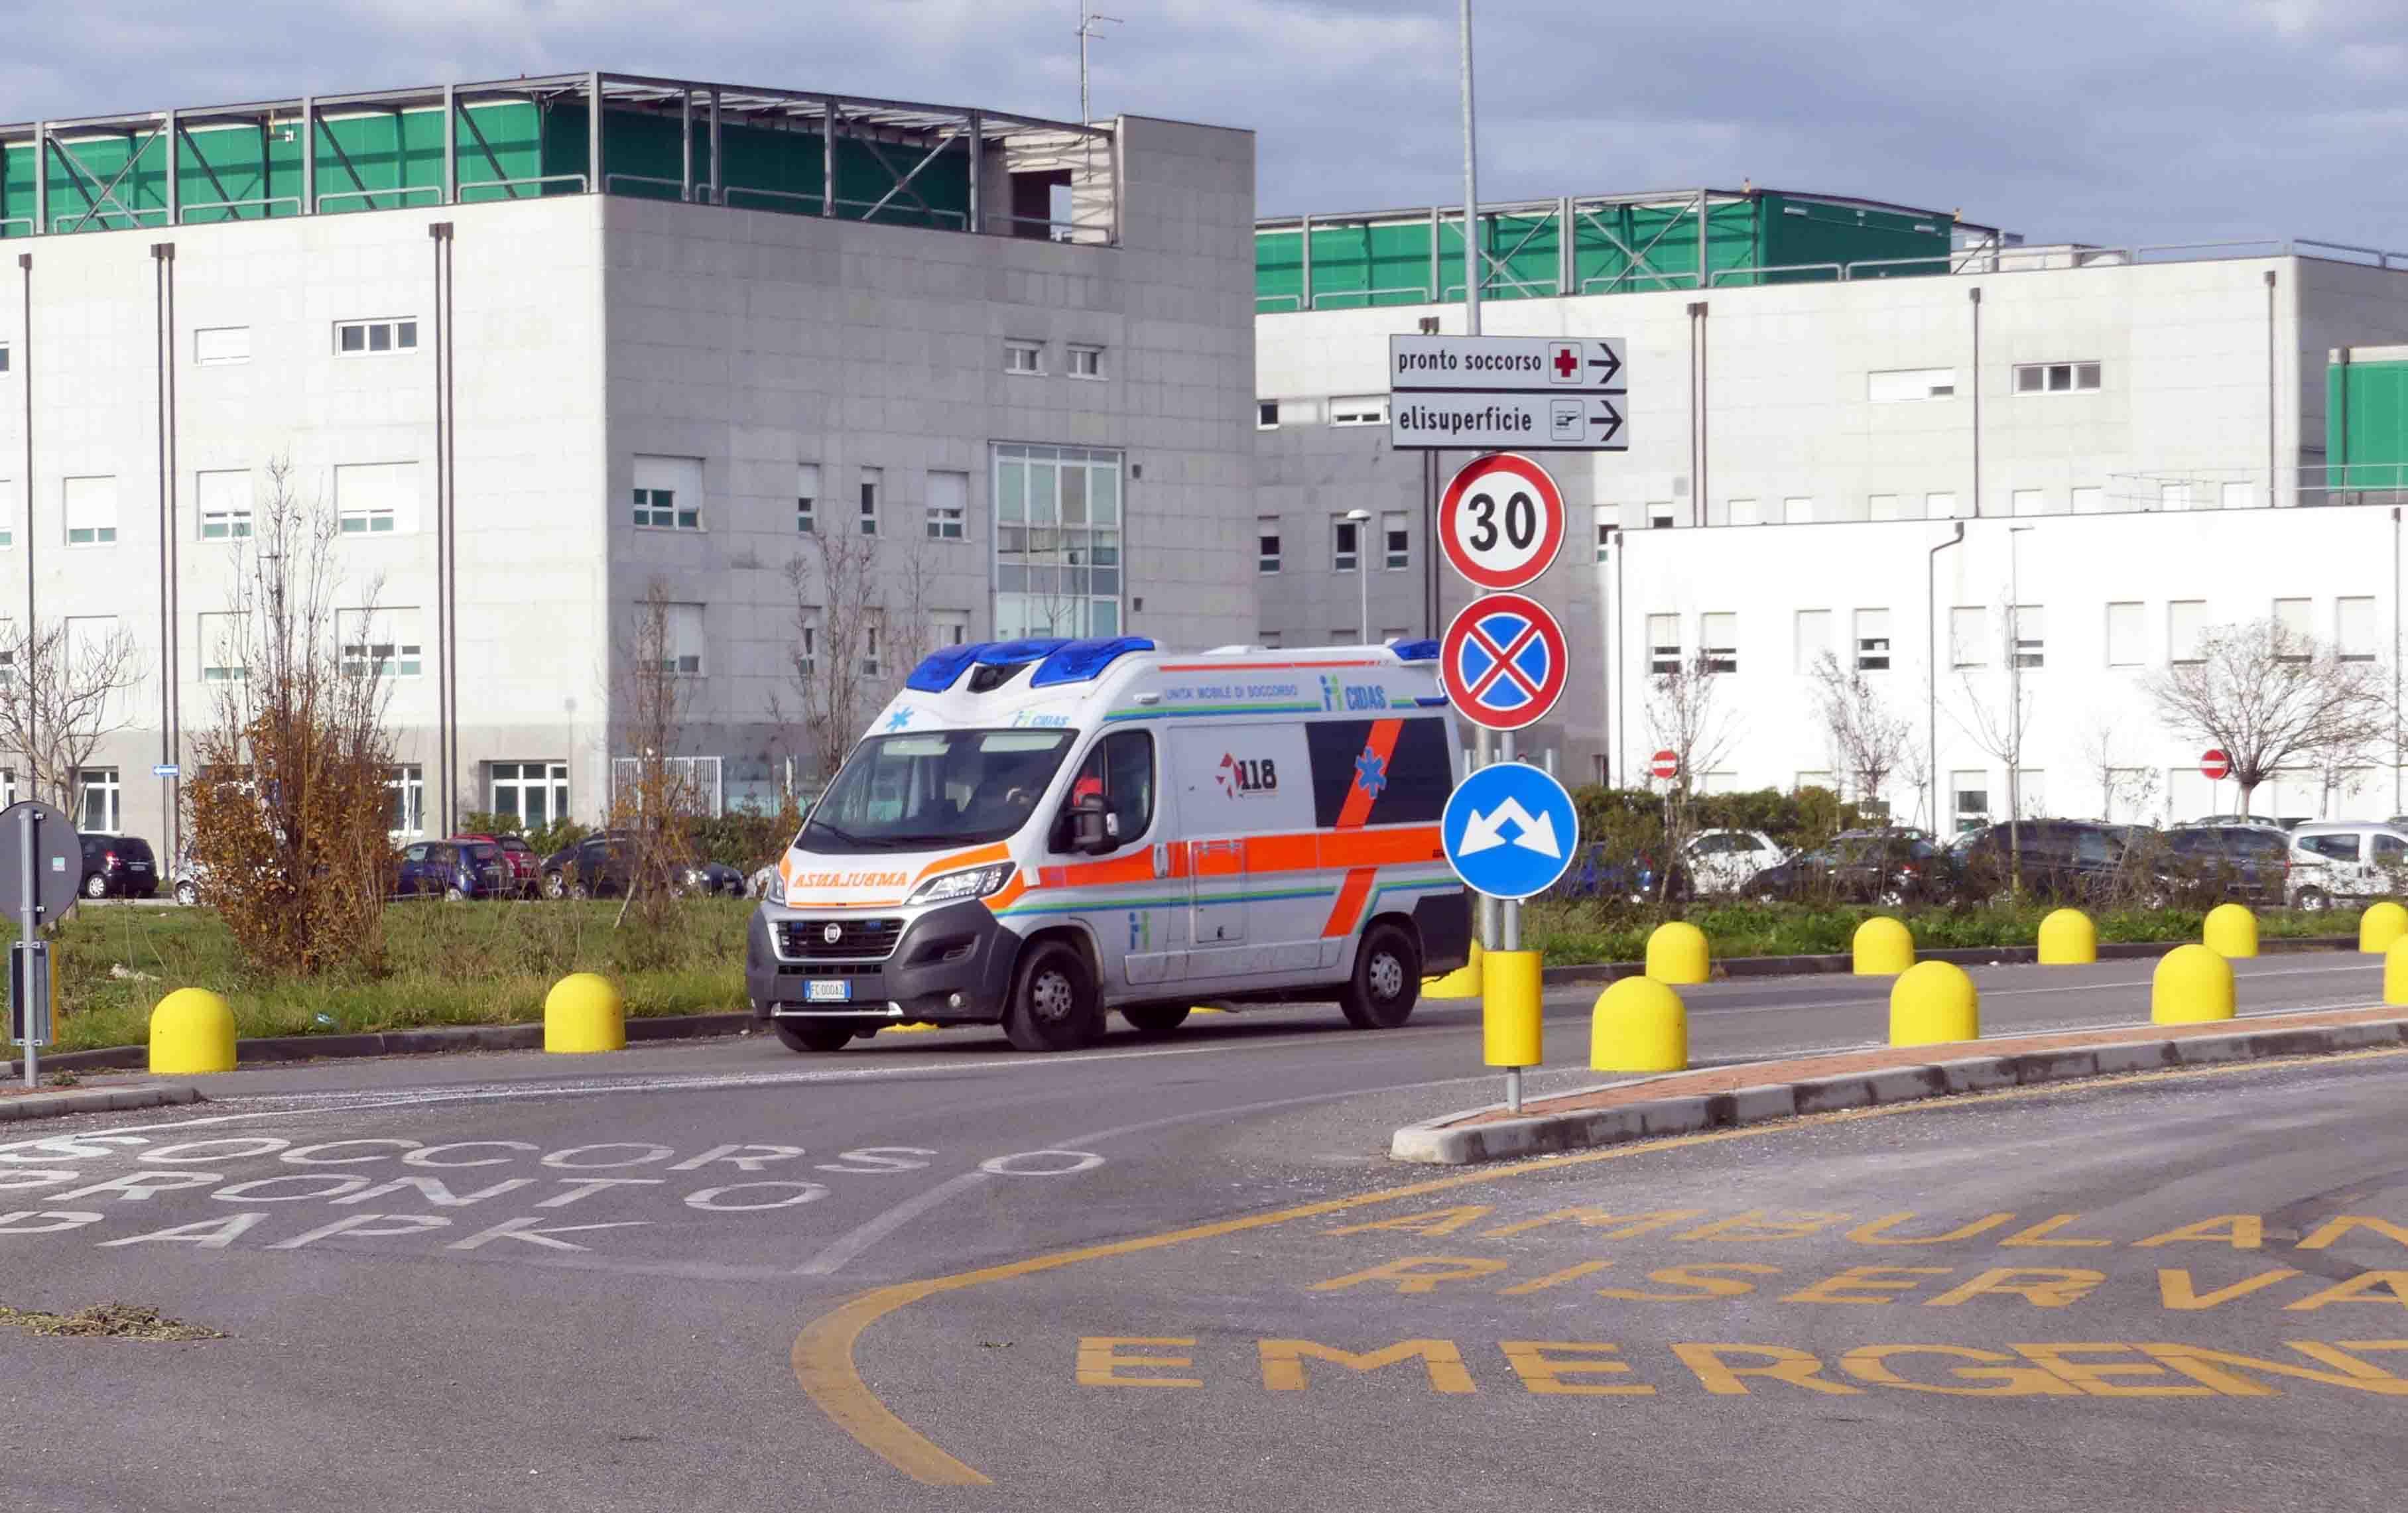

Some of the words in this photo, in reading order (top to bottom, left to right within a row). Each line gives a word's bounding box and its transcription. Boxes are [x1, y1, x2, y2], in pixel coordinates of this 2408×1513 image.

[1397, 349, 1458, 373] pronto
[1464, 353, 1542, 371] soccorso
[1399, 404, 1533, 436] elisuperficie
[1468, 491, 1537, 552] 30
[1346, 684, 1387, 710] CIDAS
[1238, 758, 1277, 790] 118
